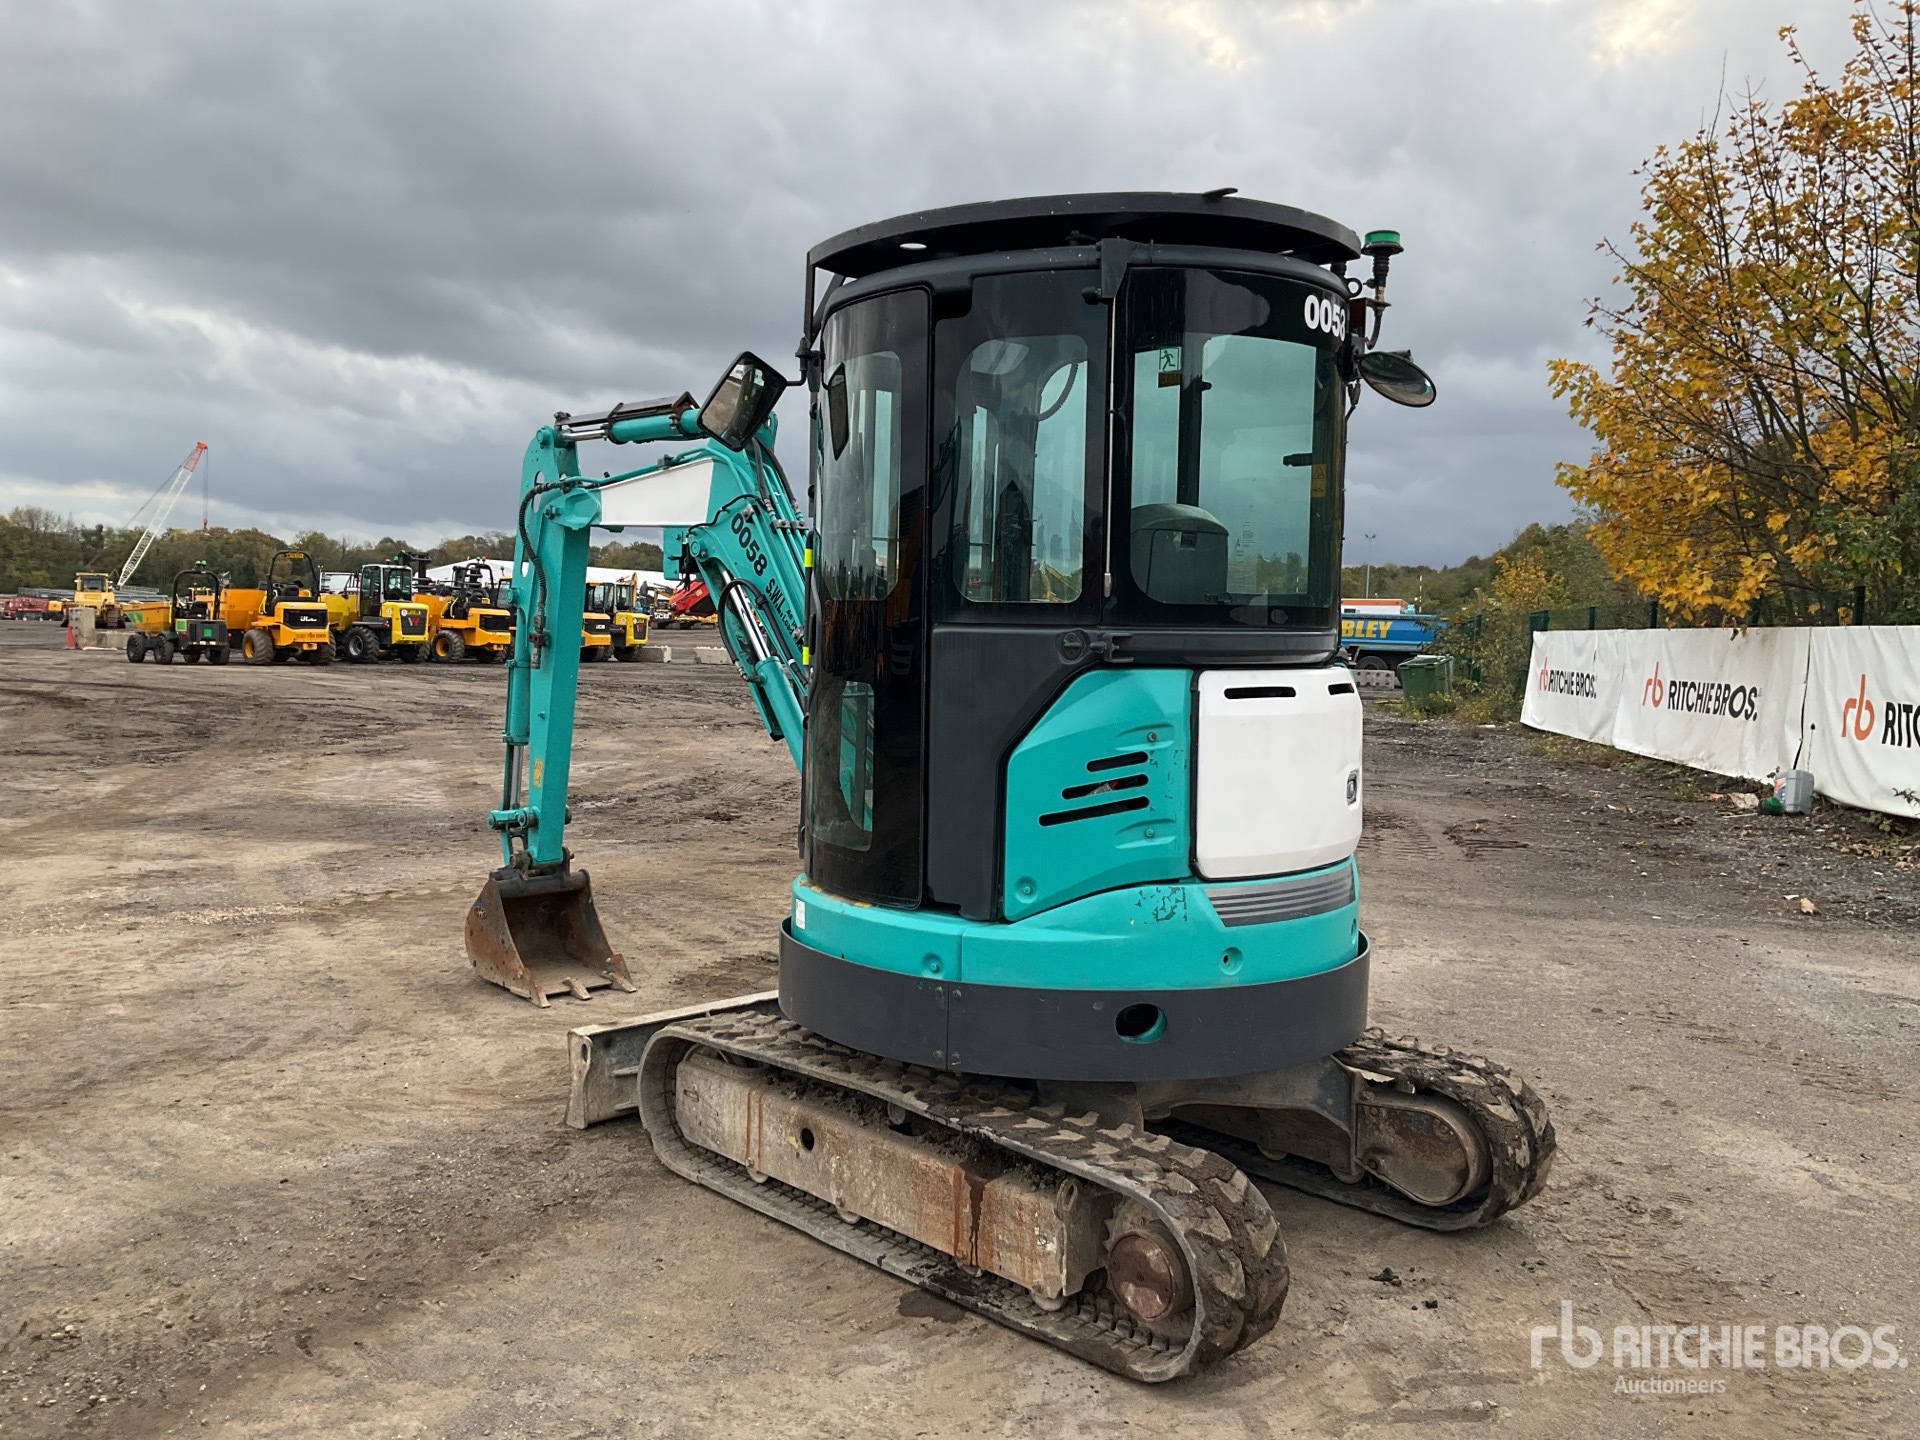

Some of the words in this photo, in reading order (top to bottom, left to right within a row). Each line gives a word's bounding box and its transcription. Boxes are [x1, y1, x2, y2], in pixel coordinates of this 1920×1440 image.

[1304, 294, 1346, 341] 0058
[730, 512, 767, 577] 0058
[1548, 670, 1575, 696] RITCHIE
[1576, 672, 1597, 699] BROS.
[1642, 661, 1664, 709] rb
[1667, 680, 1716, 714] RITCHIE
[1712, 683, 1758, 722] BROS.
[1841, 673, 1875, 741] rb
